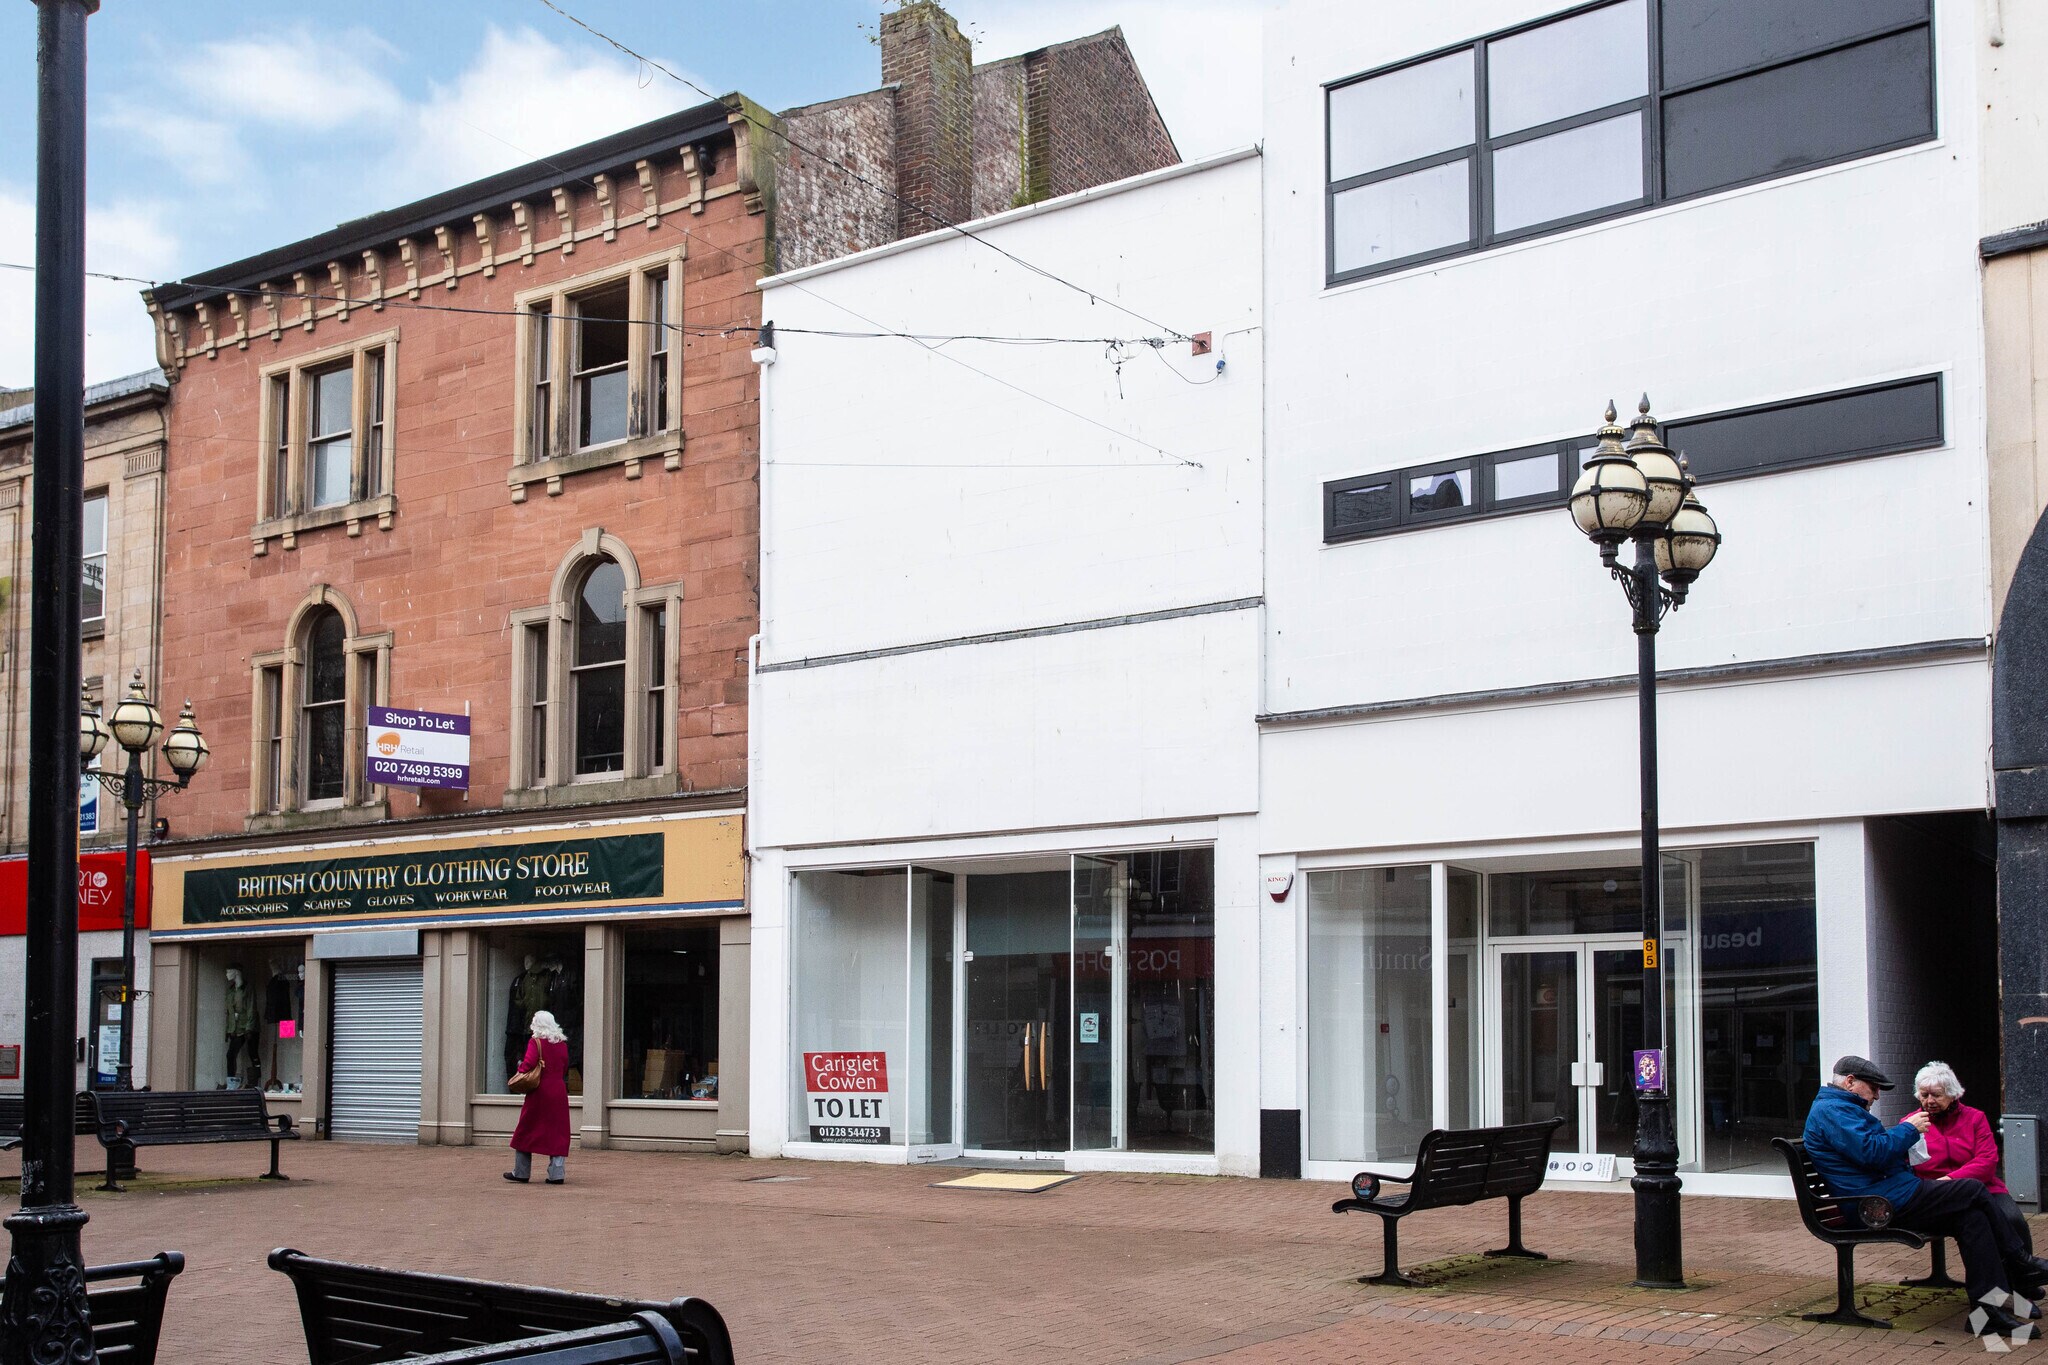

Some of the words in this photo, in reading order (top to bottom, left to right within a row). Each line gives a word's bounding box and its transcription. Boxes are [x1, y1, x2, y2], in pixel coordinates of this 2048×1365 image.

[385, 712, 417, 728] Shop
[418, 716, 434, 728] To
[435, 717, 455, 730] Let
[377, 742, 399, 752] HRH
[400, 744, 425, 756] Retail
[375, 761, 398, 773] 020
[400, 763, 431, 776] 7499
[433, 766, 463, 779] 5399
[397, 775, 441, 785] hrhretail.com
[238, 872, 306, 898] BRITISH
[308, 865, 402, 894] COUNTRY
[403, 857, 512, 888] CLOTHING
[515, 851, 590, 880] STORE
[219, 901, 289, 917] ACCESSORIES
[303, 897, 352, 912] SCARVES
[366, 893, 415, 907] GLOVES
[435, 888, 509, 904] WORKWEAR
[534, 881, 612, 897] FOOTWEAR
[1645, 941, 1653, 951] 8
[1645, 955, 1654, 966] 5
[811, 1054, 879, 1077] Carigiet
[816, 1072, 877, 1090] Cowen
[814, 1098, 844, 1118] TO
[848, 1099, 883, 1119] LET
[819, 1127, 846, 1137] 01228
[848, 1128, 881, 1138] 544733
